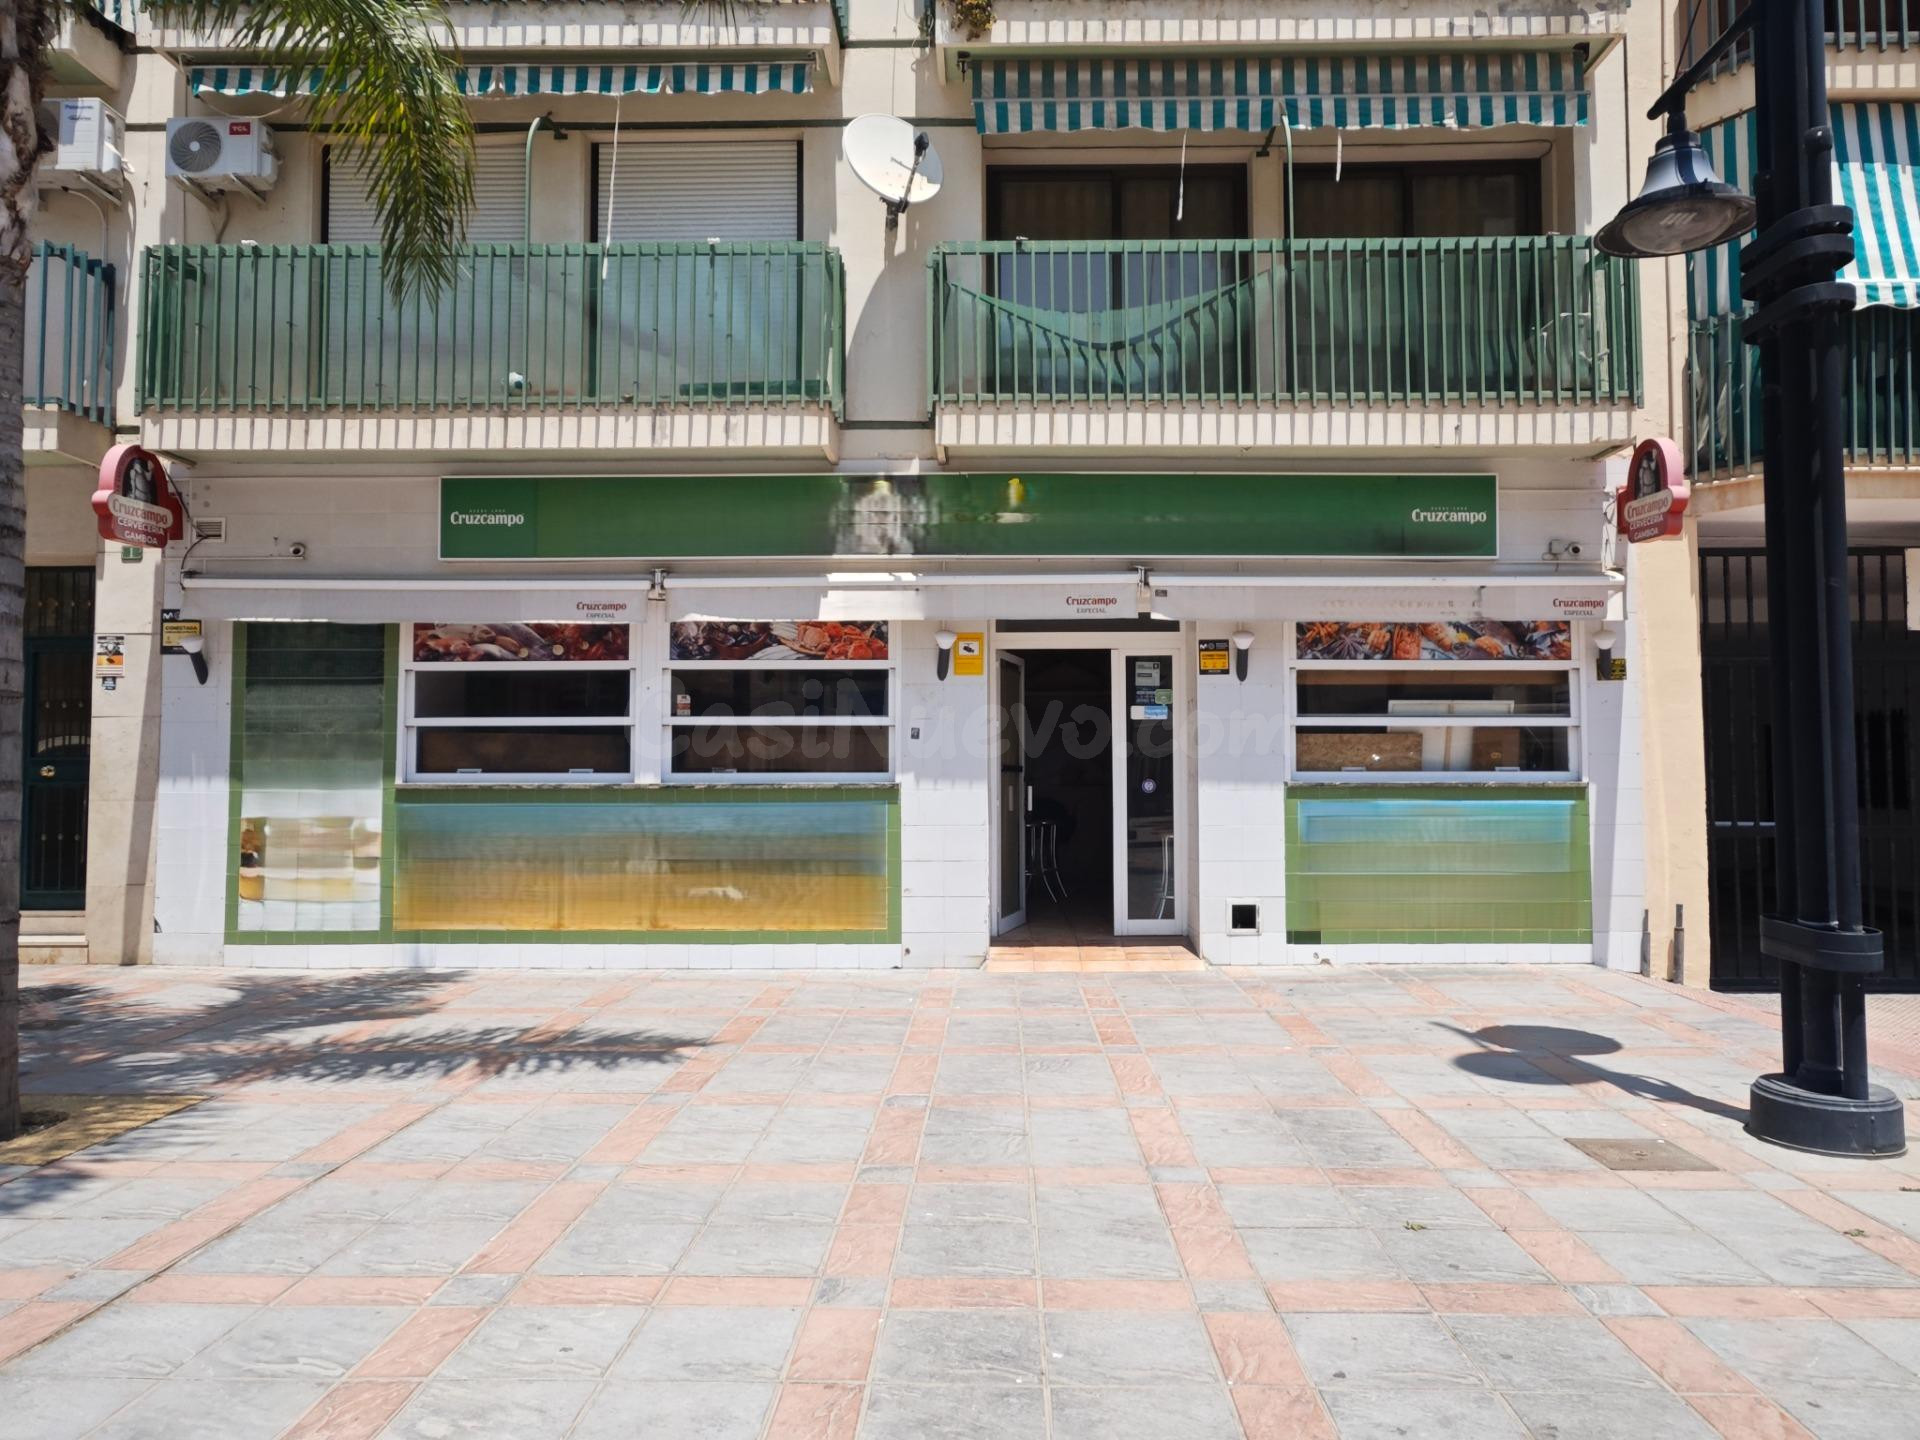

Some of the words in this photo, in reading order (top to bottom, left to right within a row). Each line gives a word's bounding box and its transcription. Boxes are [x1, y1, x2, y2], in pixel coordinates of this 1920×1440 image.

[112, 498, 168, 527] Cruzcampo
[1412, 508, 1487, 524] Cruzcampo
[1627, 496, 1669, 520] Cruzcampo
[450, 511, 524, 527] Cruzcampo
[576, 601, 627, 611] Cruzcampo
[1066, 596, 1118, 606] Cruzcampo
[1552, 598, 1605, 608] Cruzcampo
